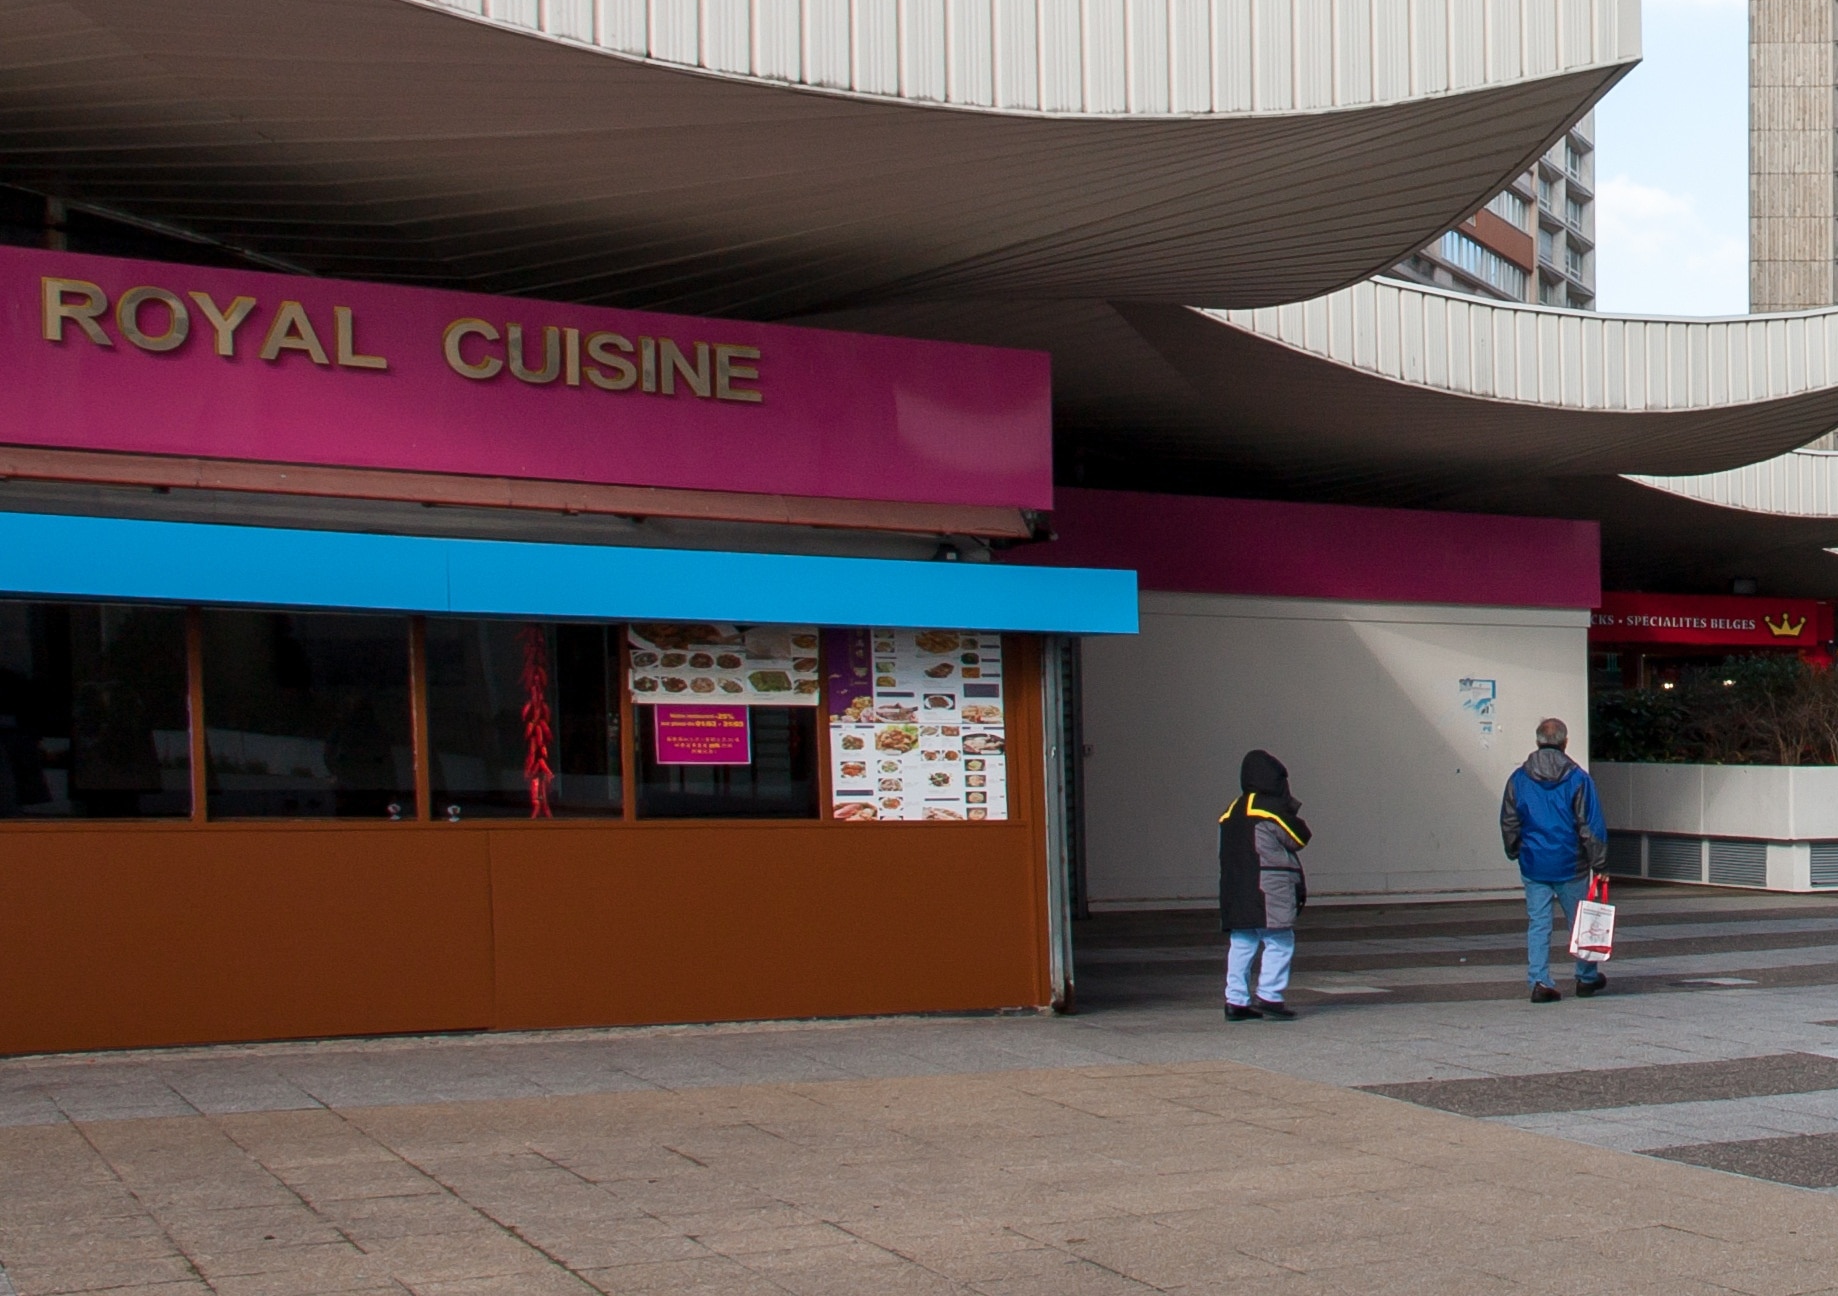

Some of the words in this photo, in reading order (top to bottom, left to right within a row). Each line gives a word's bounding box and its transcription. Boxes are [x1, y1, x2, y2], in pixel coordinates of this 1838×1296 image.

[41, 276, 387, 369] ROYAL
[443, 317, 762, 402] CUISINE
[1710, 618, 1756, 630] BELGES
